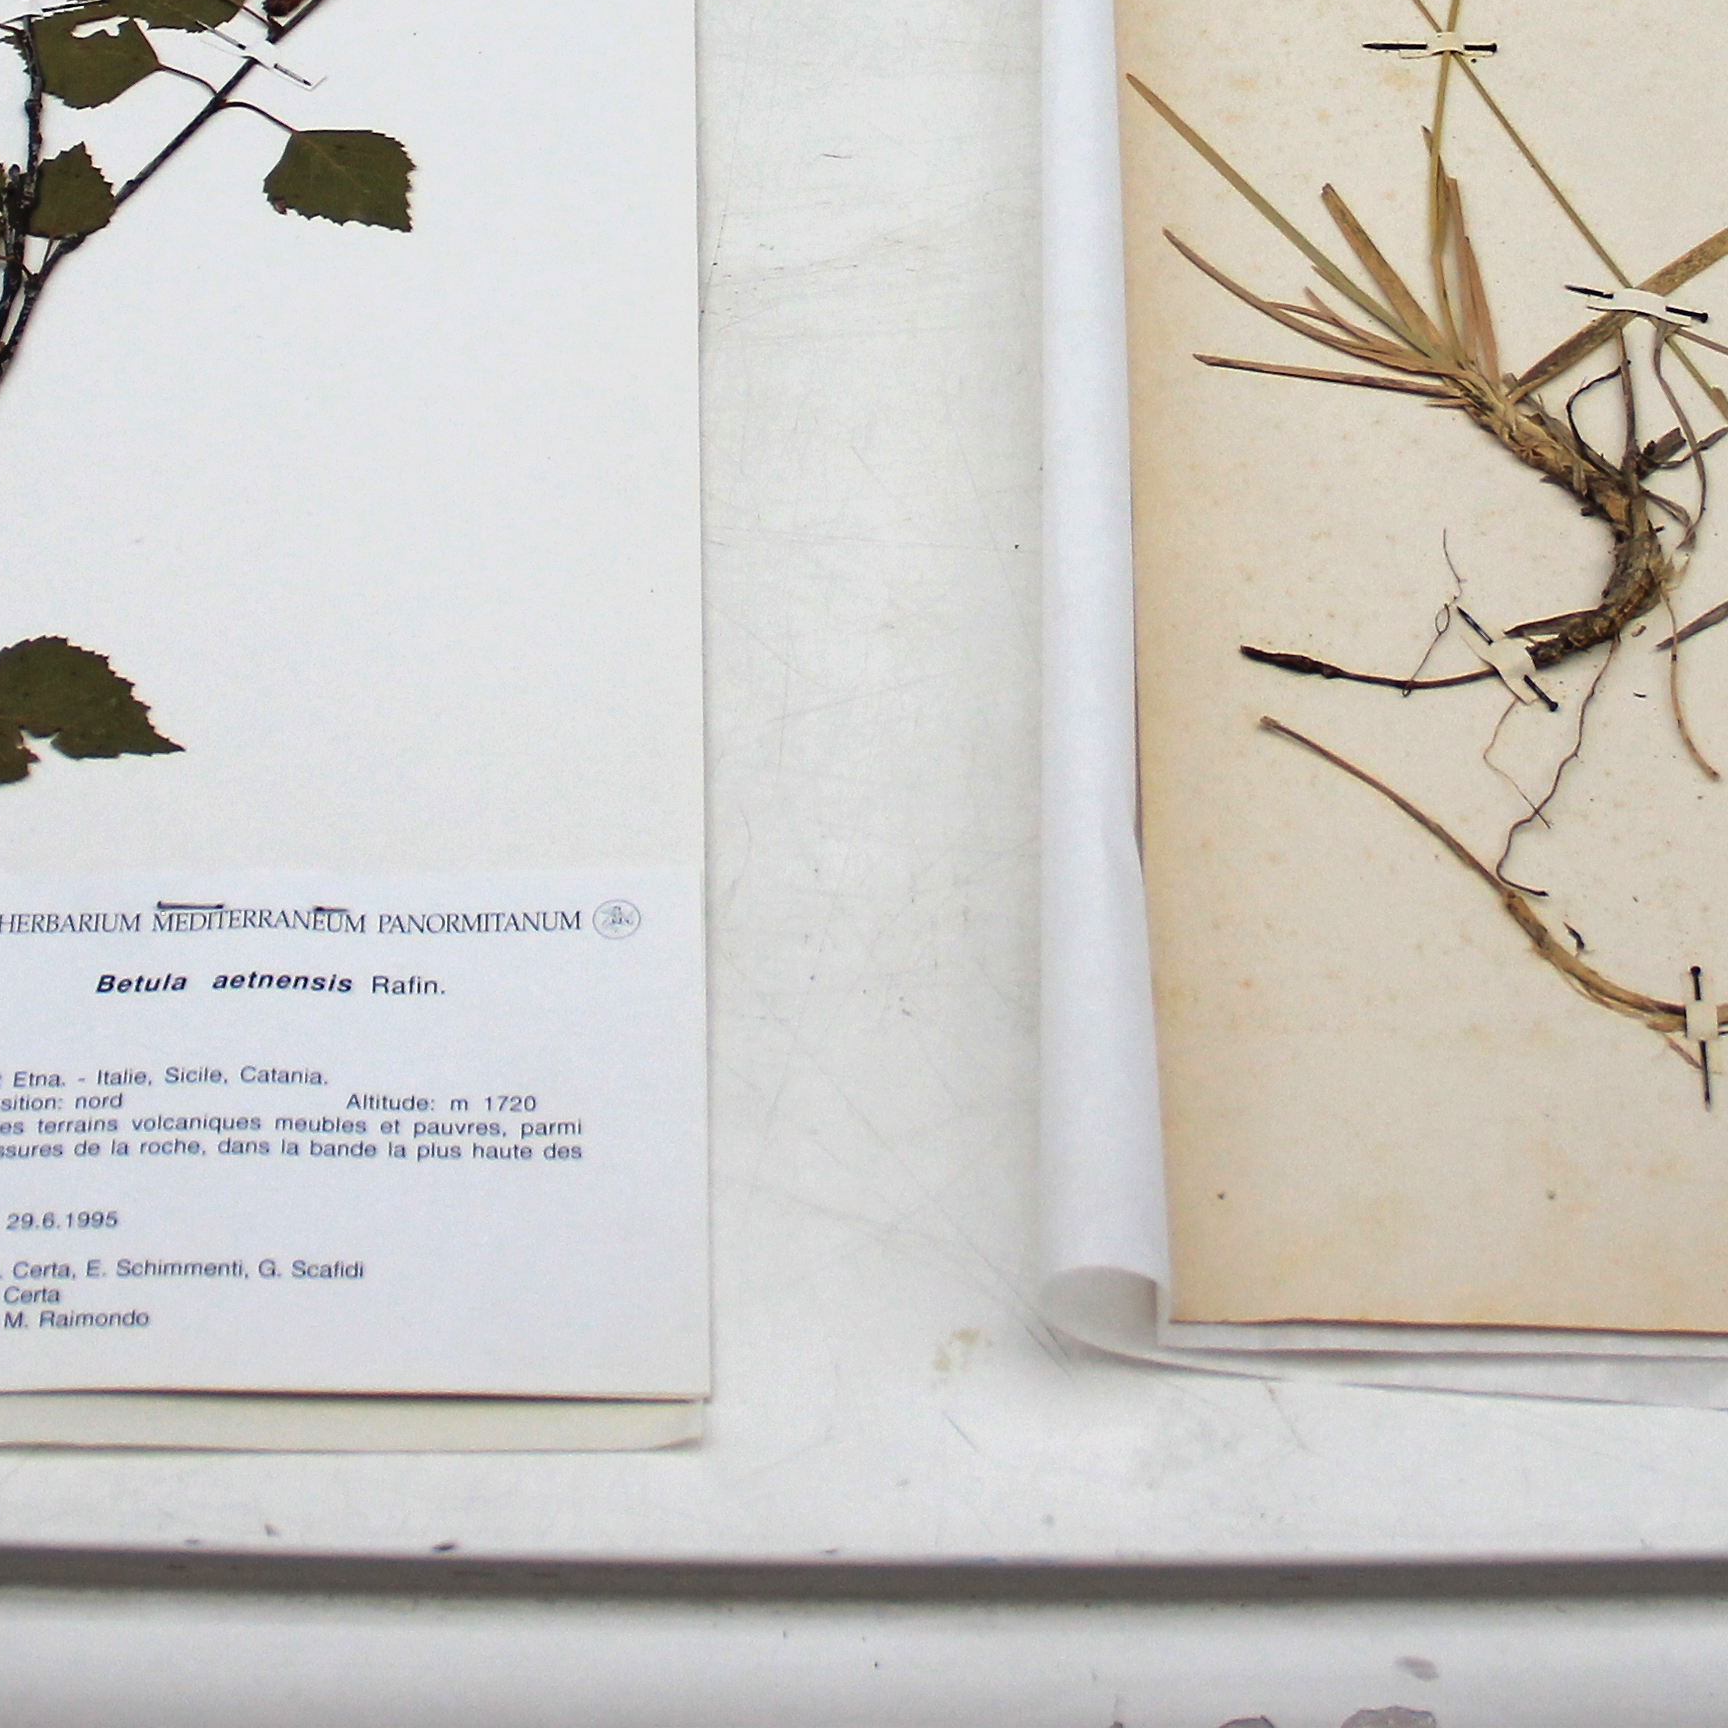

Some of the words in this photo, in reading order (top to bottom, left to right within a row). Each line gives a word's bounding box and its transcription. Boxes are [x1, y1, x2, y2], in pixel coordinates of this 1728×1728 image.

[151, 909, 366, 934] MEDITERRANEUM
[377, 911, 582, 934] PANORMITANUM
[96, 973, 189, 993] Betula
[212, 970, 353, 993] aetnensis
[371, 975, 446, 995] Rafin.
[13, 1072, 66, 1088] Etna.
[97, 1069, 152, 1089] Italie,
[164, 1067, 228, 1088] Sicile,
[239, 1066, 329, 1086] Catania.
[74, 1092, 123, 1110] nord
[345, 1094, 436, 1112] Altitude:
[449, 1098, 469, 1112] m
[484, 1095, 538, 1113] 1720
[37, 1117, 119, 1135] terrains
[132, 1115, 262, 1136] volcaniques
[274, 1116, 367, 1134] meubles
[380, 1117, 401, 1135] et
[413, 1120, 507, 1141] pauvres,
[520, 1118, 583, 1140] parmi
[73, 1139, 101, 1157] de
[110, 1139, 129, 1157] la
[140, 1138, 206, 1158] roche,
[217, 1138, 270, 1157] dans
[281, 1138, 299, 1157] la
[309, 1139, 377, 1158] bande
[388, 1140, 407, 1159] la
[416, 1142, 462, 1162] plus
[472, 1142, 532, 1160] haute
[543, 1142, 583, 1160] des
[6, 1211, 119, 1231] 29.6.1995
[12, 1262, 76, 1282] Certa,
[85, 1260, 106, 1278] E.
[115, 1258, 249, 1281] Schimmenti,
[257, 1259, 282, 1278] G.
[290, 1259, 364, 1279] Scafidi
[3, 1285, 60, 1304] Certa
[3, 1311, 29, 1329] M.
[39, 1309, 150, 1328] Raimondo
